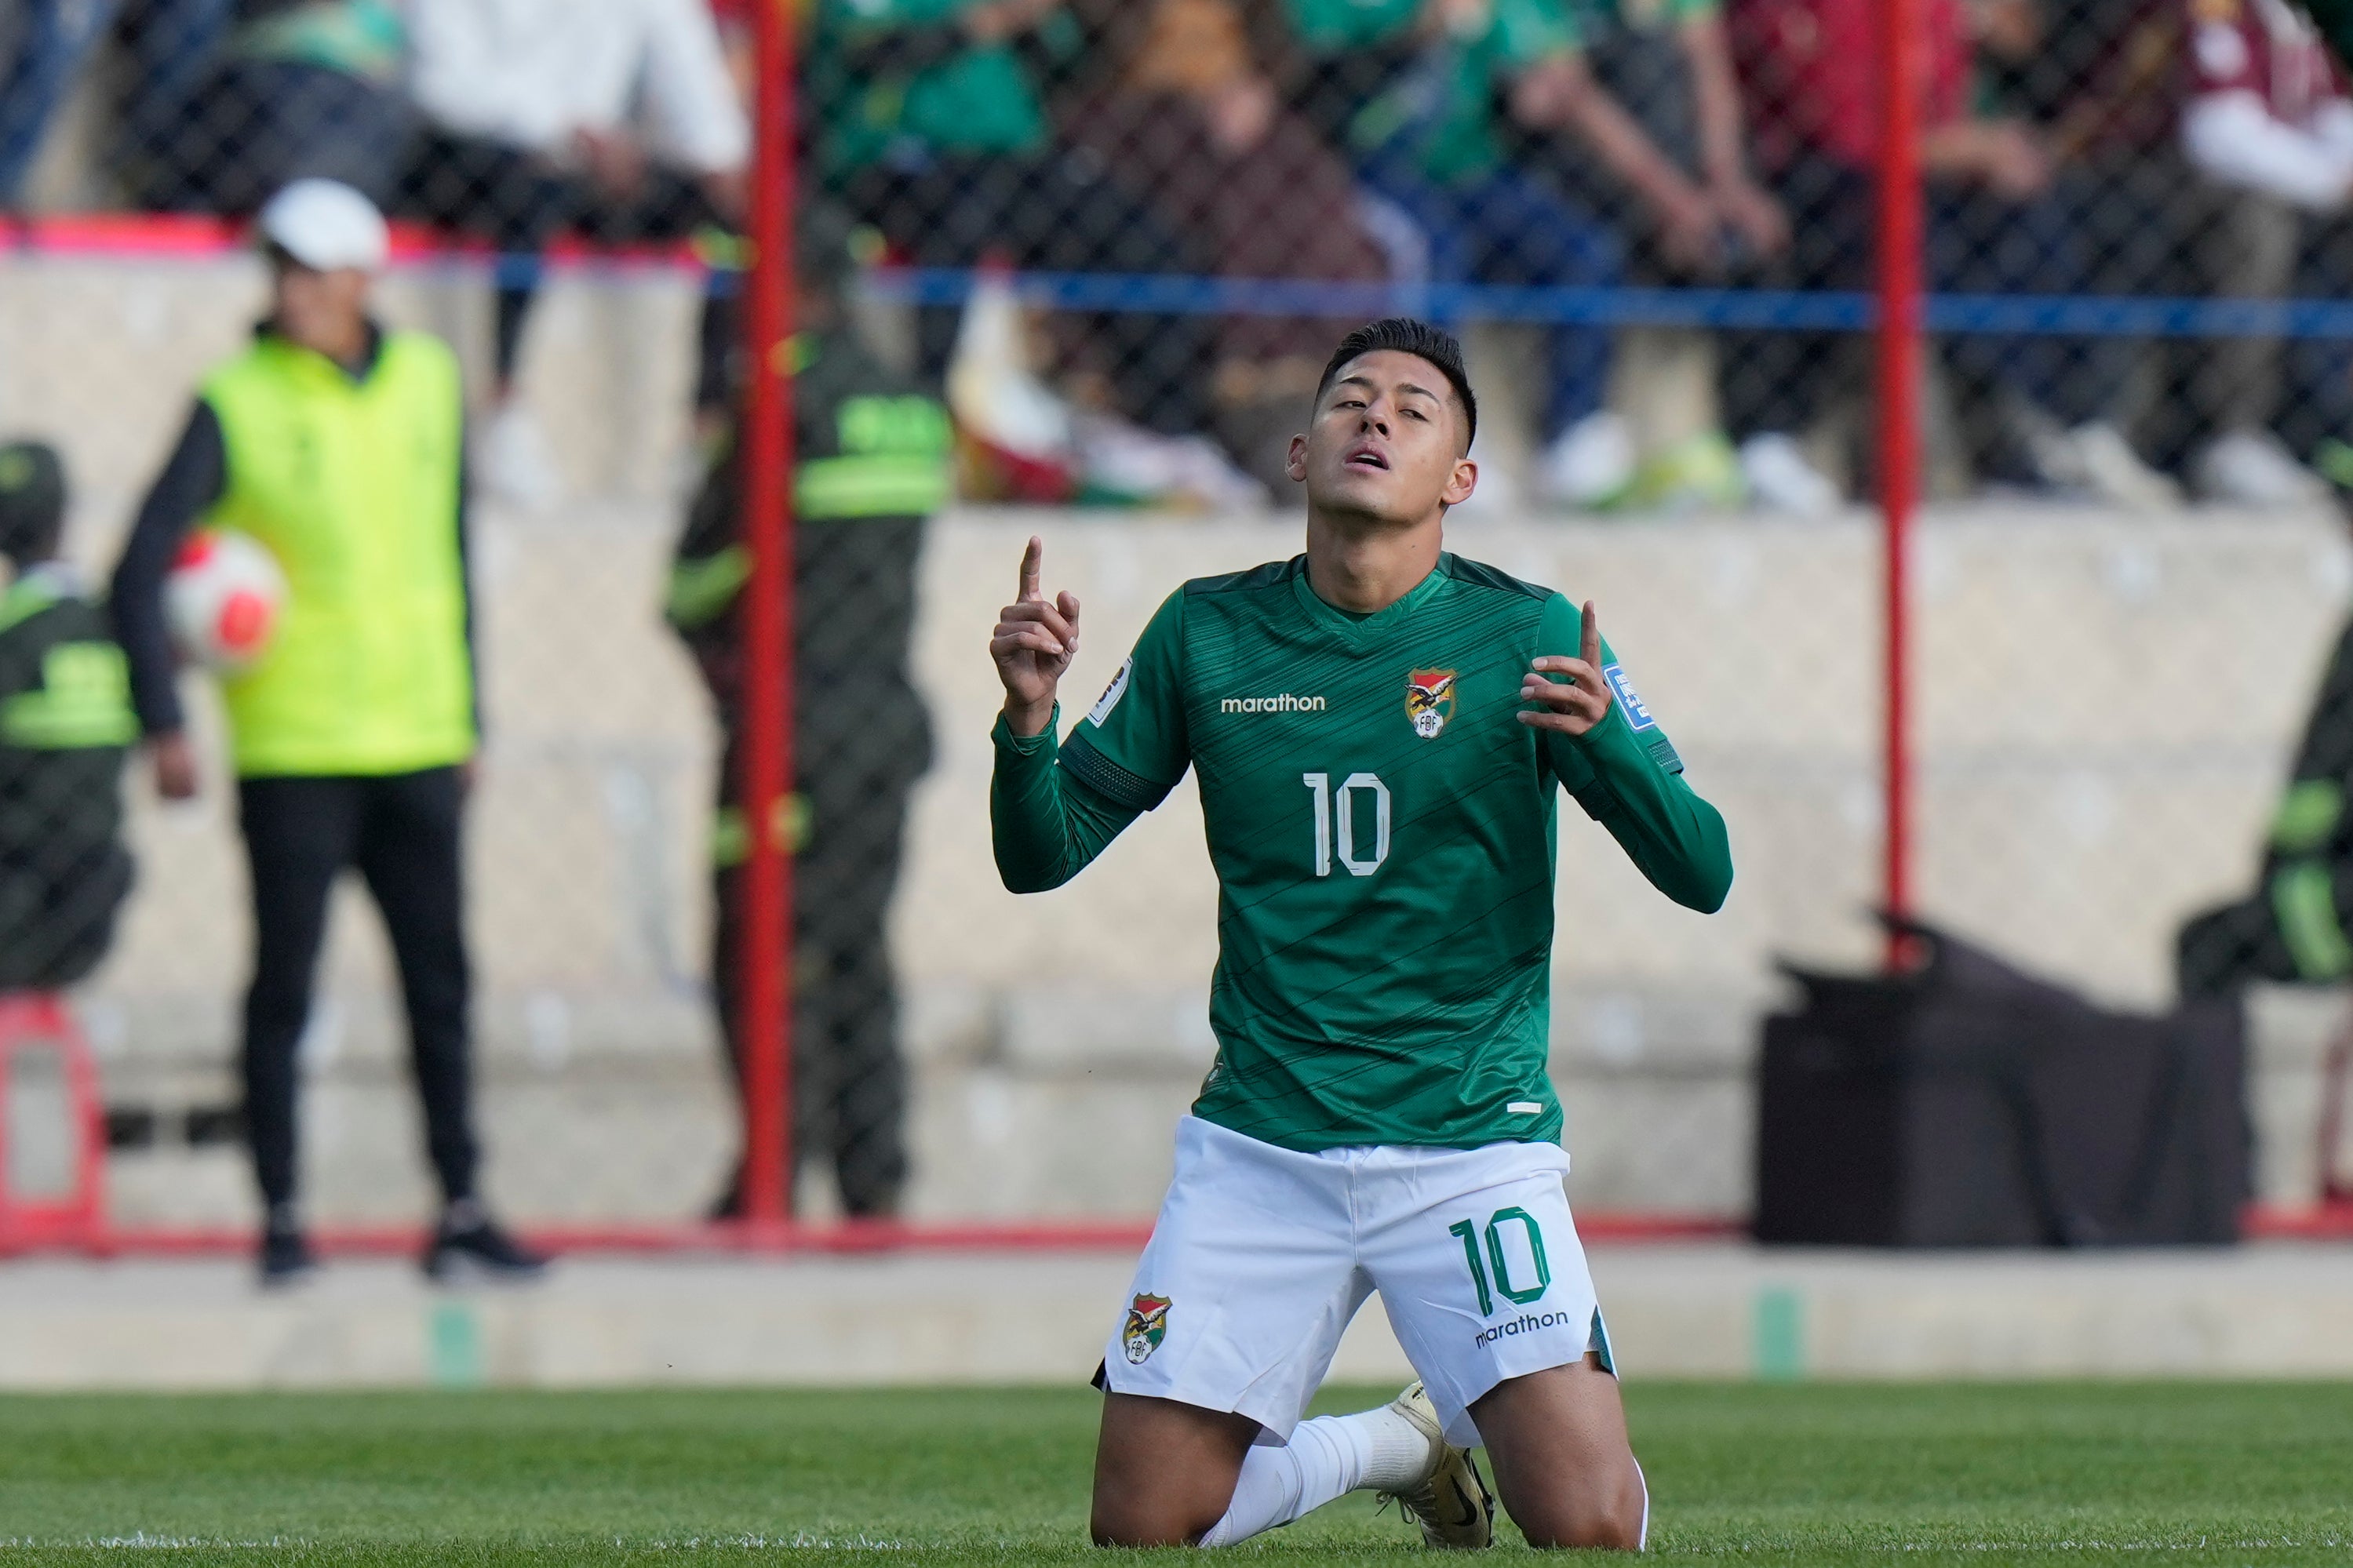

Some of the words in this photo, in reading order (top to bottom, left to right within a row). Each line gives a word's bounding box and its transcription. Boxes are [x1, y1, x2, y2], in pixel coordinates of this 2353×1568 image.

[1221, 693, 1326, 713] marathon
[1419, 715, 1437, 731] FBF
[1302, 773, 1391, 876] 10
[1448, 1206, 1551, 1318] 10
[1475, 1311, 1568, 1349] marathon
[1131, 1341, 1147, 1357] FBF
